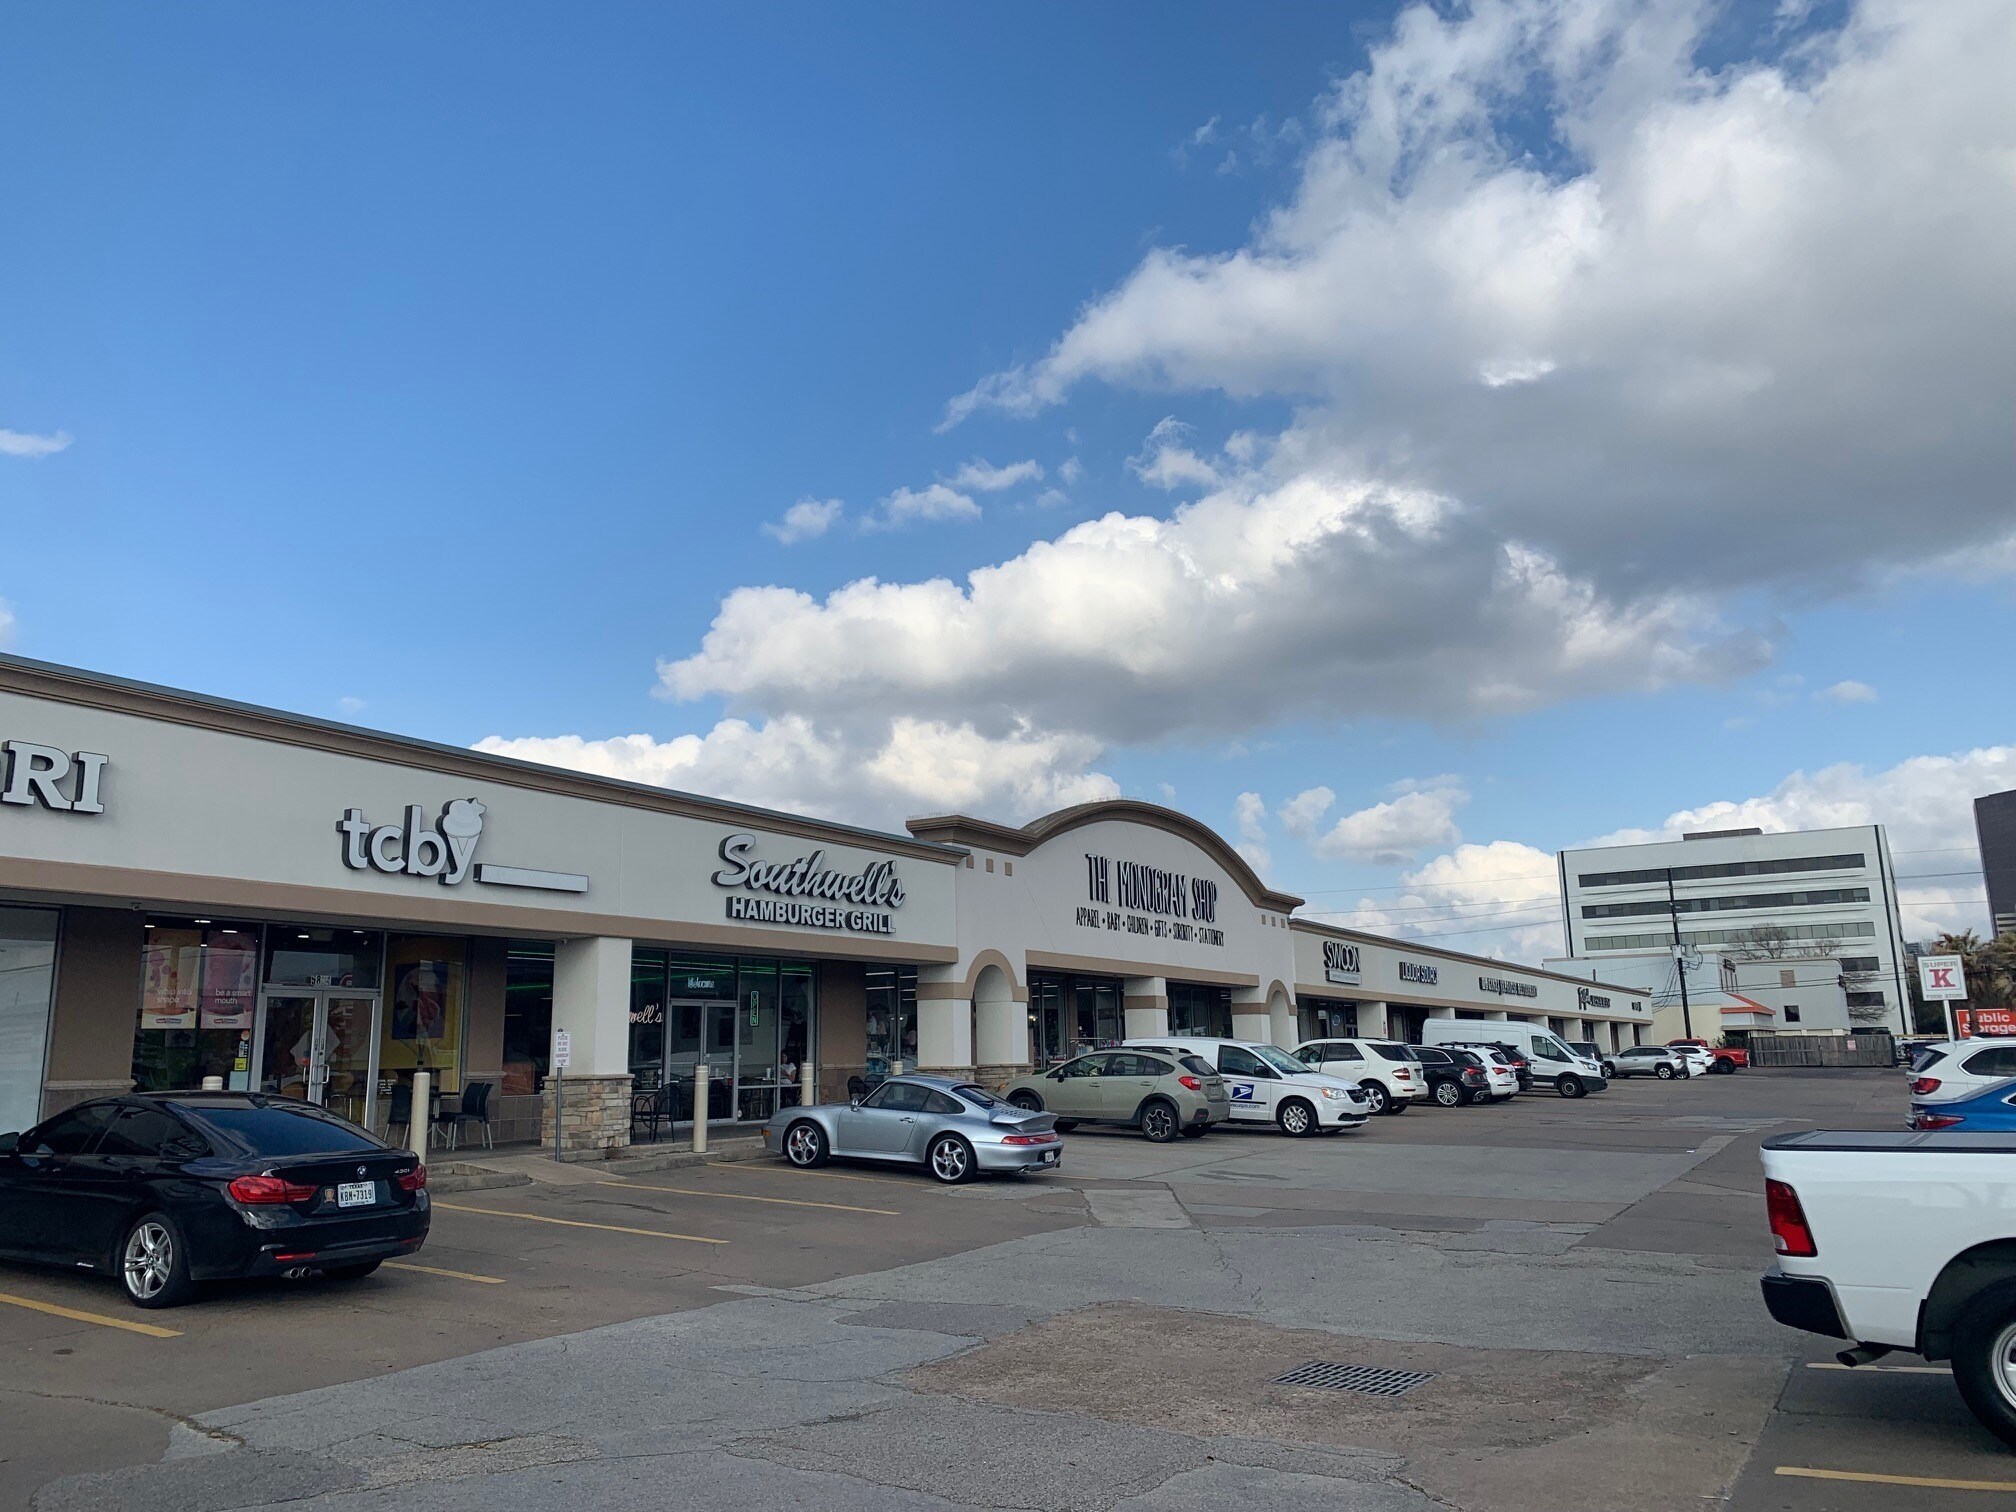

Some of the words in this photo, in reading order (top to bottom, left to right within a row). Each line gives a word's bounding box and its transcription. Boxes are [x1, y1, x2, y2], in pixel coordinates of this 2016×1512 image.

[1, 740, 109, 814] RI
[336, 798, 487, 885] tcby
[711, 834, 906, 907] Southwell's
[1085, 853, 1110, 903] THE
[1117, 860, 1187, 917] MONOGRAM
[1192, 877, 1217, 923] SHOP
[726, 896, 847, 929] HAMBURGER
[846, 910, 896, 934] GRILL
[1076, 907, 1101, 929] APPAREL
[1107, 911, 1121, 932] BABY
[1126, 914, 1149, 936] CHILDREN
[1154, 919, 1168, 938] GIFTS
[1172, 922, 1194, 942] SORORITY
[1198, 927, 1225, 947] STATIONERY
[1323, 940, 1361, 972] SWOON
[215, 988, 225, 996] be
[231, 989, 252, 997] smart
[1929, 968, 1956, 988] K
